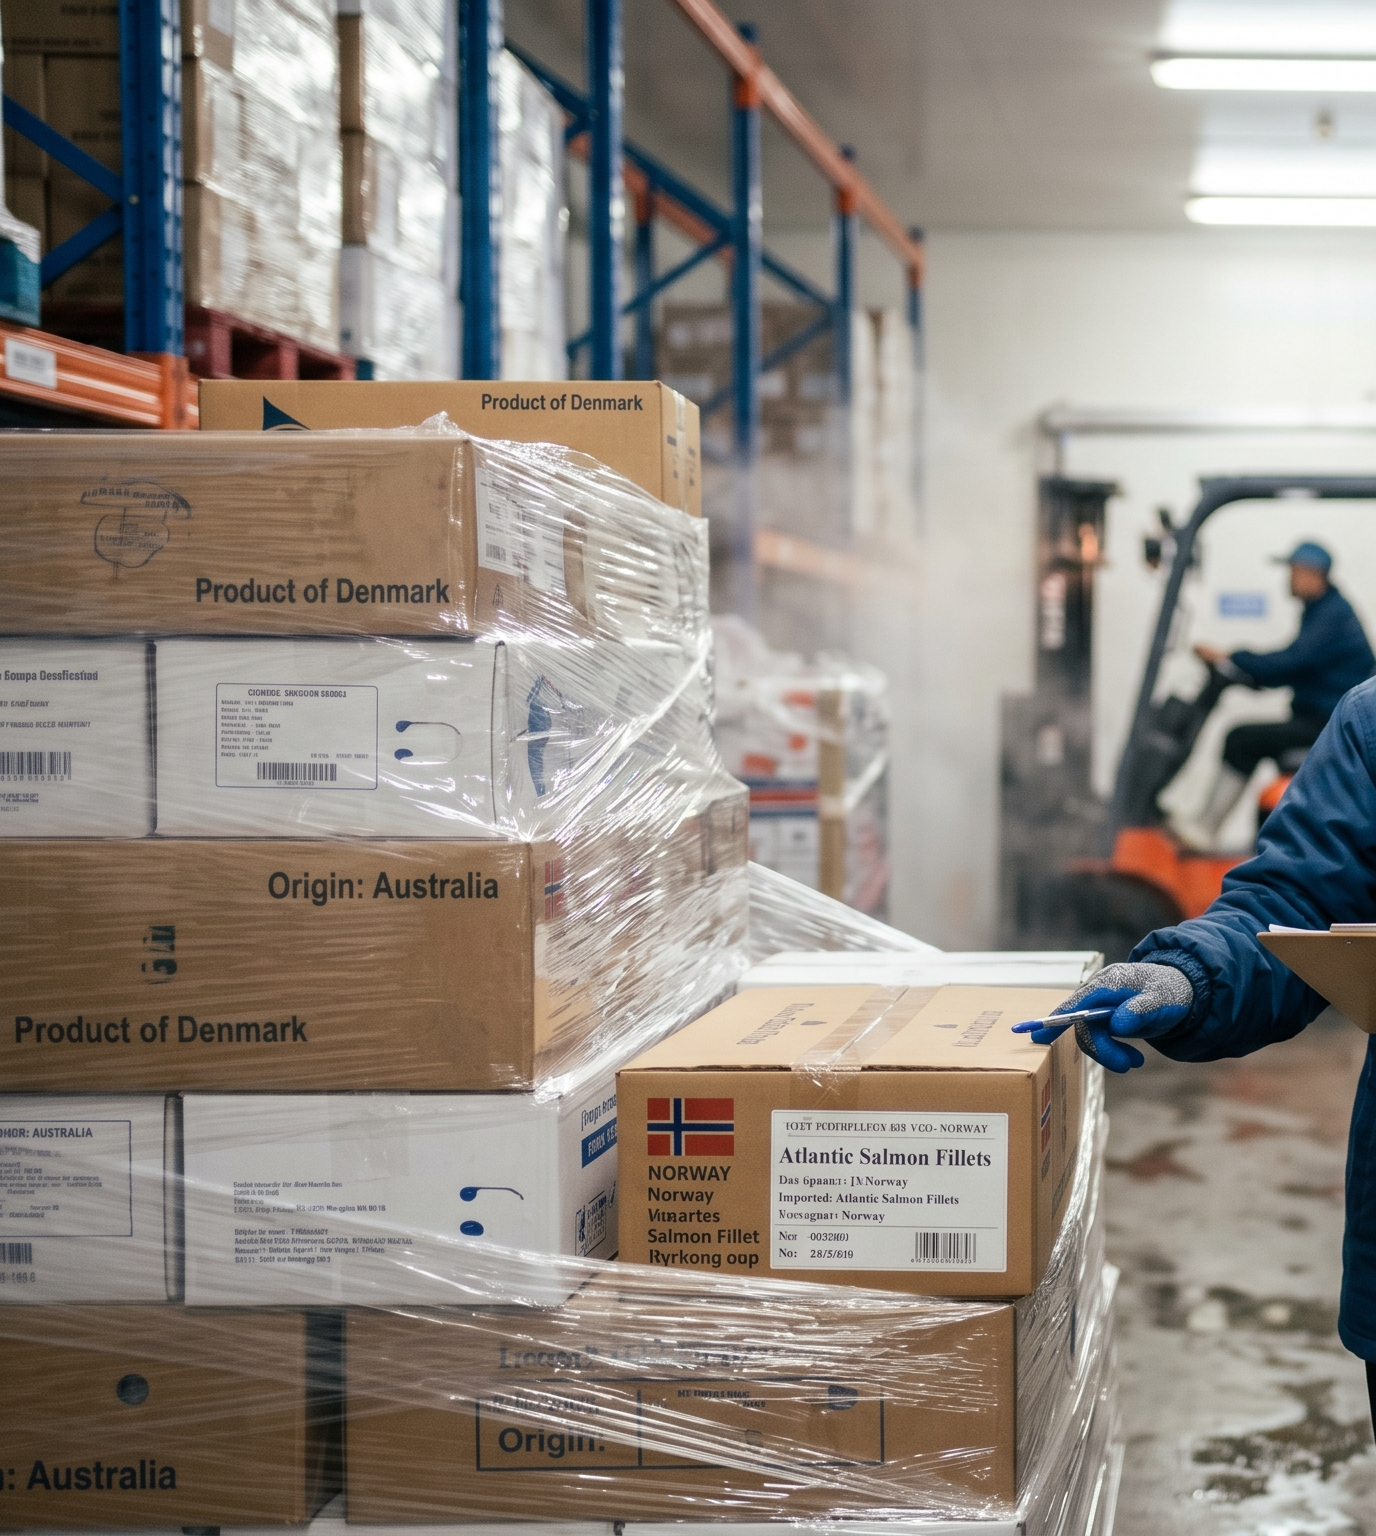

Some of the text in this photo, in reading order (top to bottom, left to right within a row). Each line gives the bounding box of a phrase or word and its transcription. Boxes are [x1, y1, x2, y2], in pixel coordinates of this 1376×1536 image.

[481, 393, 644, 412] Product of Denmark
[196, 577, 450, 604] Product of Denmark
[267, 871, 499, 906] Origin: Australia
[15, 1014, 308, 1044] Product of Denmark
[32, 1127, 94, 1138] AUSTRALIA
[940, 1123, 988, 1134] NORWAY
[779, 1146, 992, 1167] Atlantic Salmon Fillets
[648, 1165, 732, 1181] NORWAY
[779, 1175, 800, 1185] Das
[648, 1187, 715, 1206] Norway
[779, 1192, 960, 1205] Imported: Atlantic Salmon Fillets
[841, 1210, 886, 1223] Norway
[647, 1228, 760, 1244] Salmon Fillet
[779, 1249, 798, 1258] No:
[498, 1427, 606, 1459] Origin:
[26, 1459, 178, 1491] Australia
